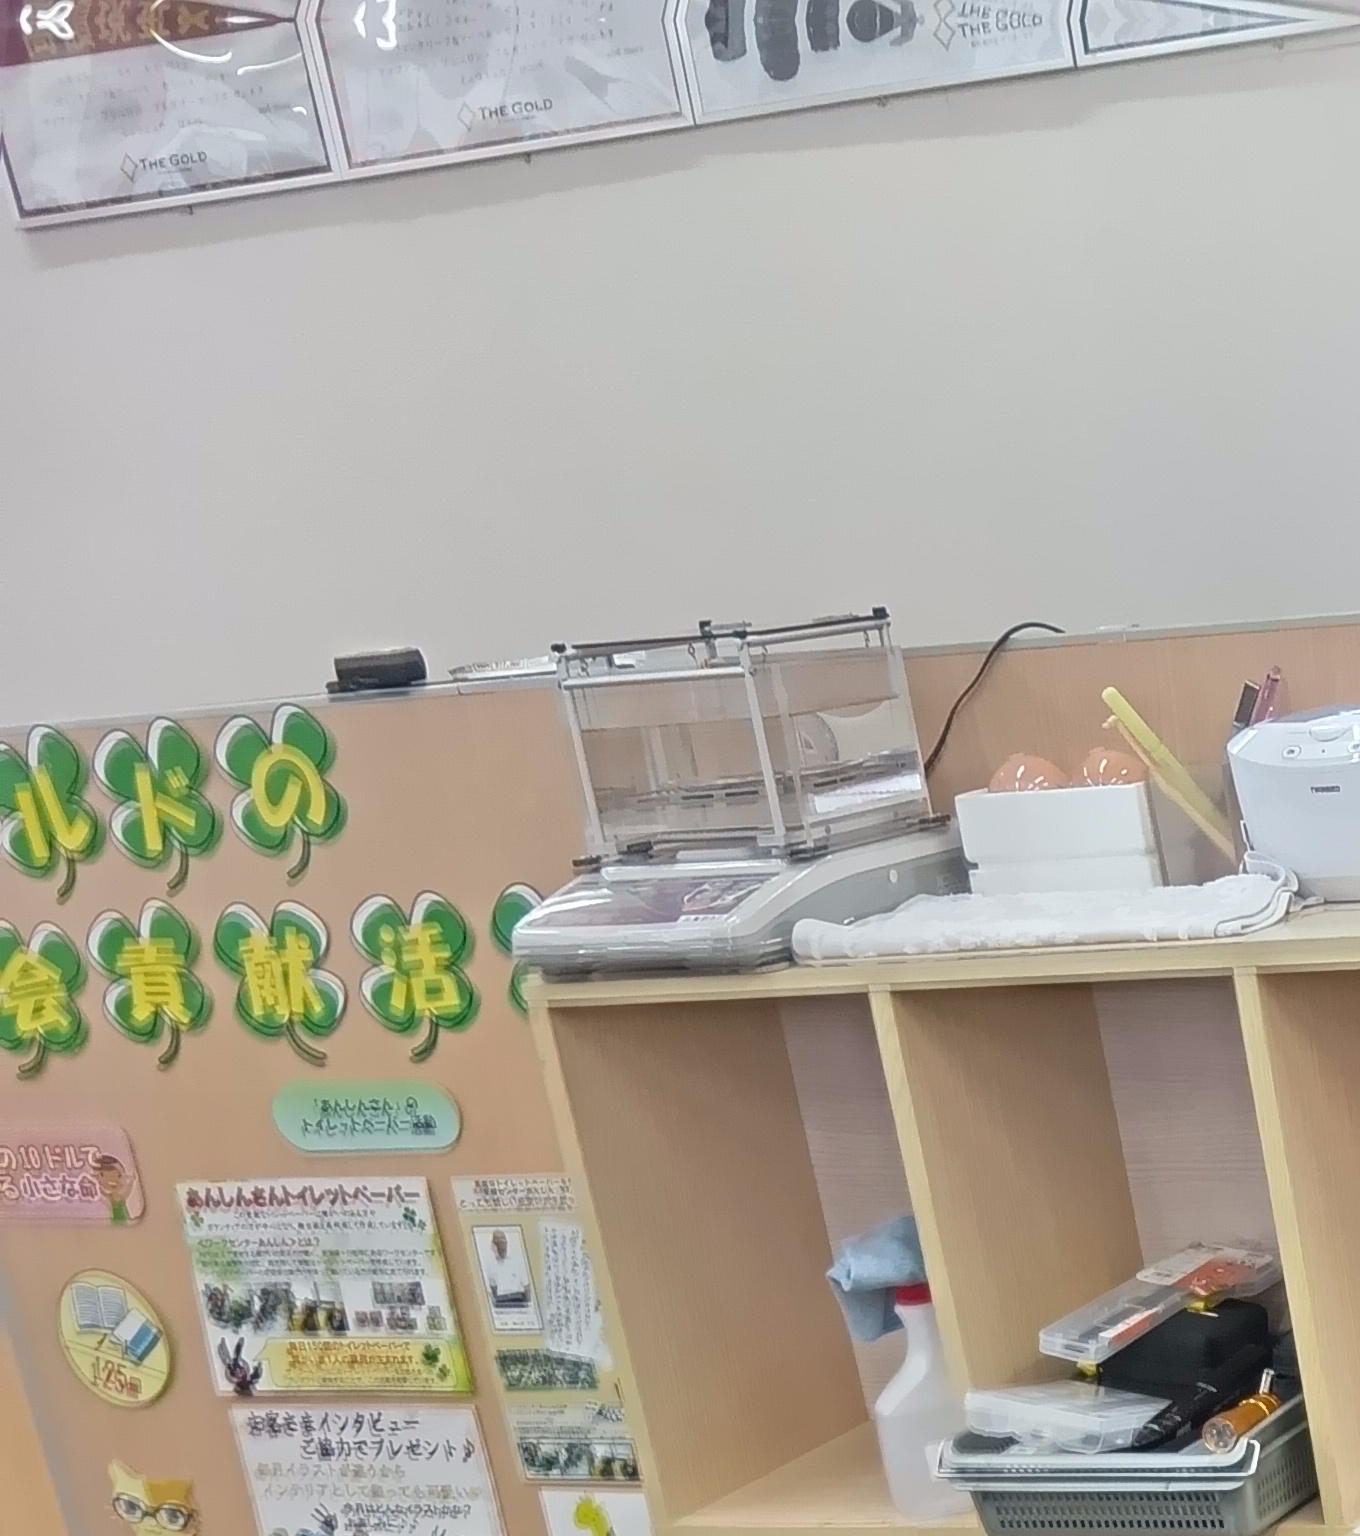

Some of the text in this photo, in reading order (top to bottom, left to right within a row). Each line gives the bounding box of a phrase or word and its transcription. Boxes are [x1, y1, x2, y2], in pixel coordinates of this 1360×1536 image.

[478, 98, 553, 120] THE GOLD
[140, 151, 207, 171] THE GOLD
